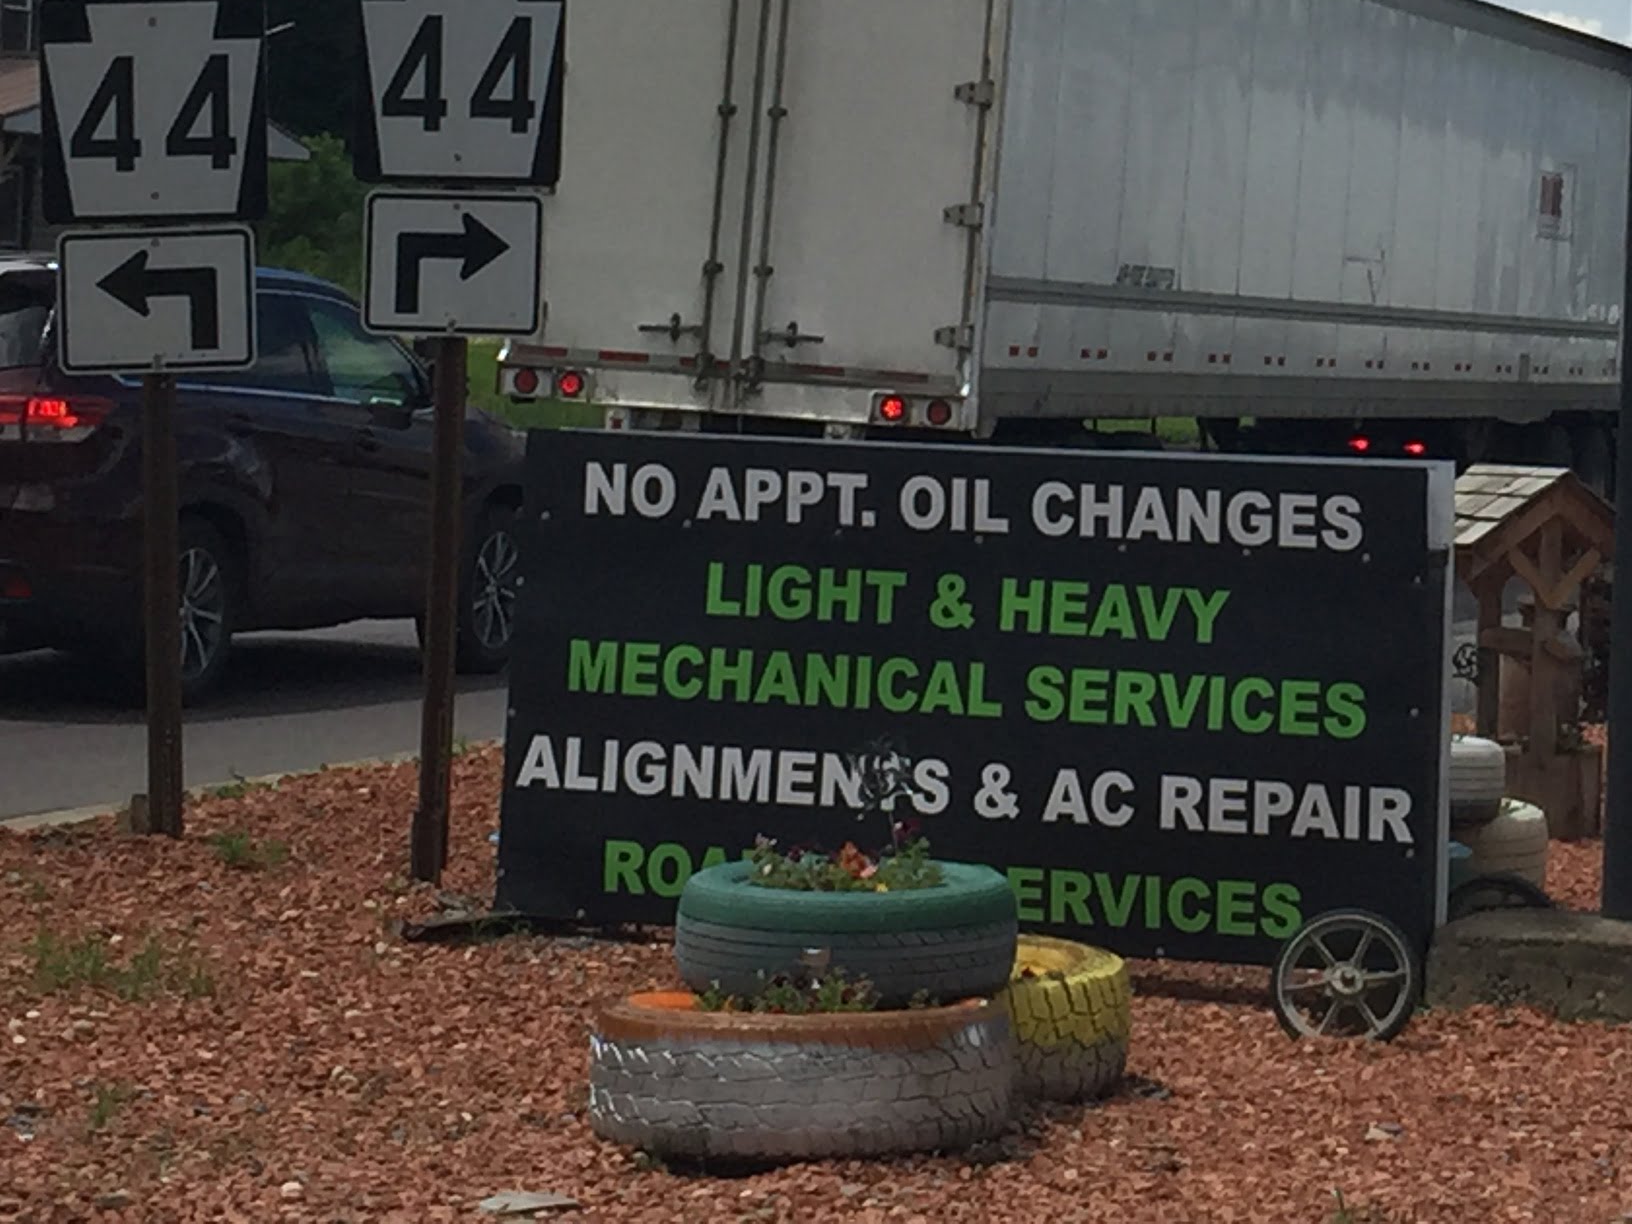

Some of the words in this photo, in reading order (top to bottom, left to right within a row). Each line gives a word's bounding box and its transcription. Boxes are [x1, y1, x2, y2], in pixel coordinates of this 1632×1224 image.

[70, 53, 237, 173] 44
[381, 14, 535, 134] 44
[584, 461, 676, 519] NO
[697, 467, 877, 528] APPT.
[900, 476, 1009, 536] OIL
[1032, 481, 1364, 551] CHANGES
[705, 561, 908, 625] LIGHT
[930, 575, 974, 630] &
[1000, 578, 1231, 644] HEAVY
[566, 639, 1001, 718] MECHANICAL
[1024, 666, 1367, 740] SERVICES
[974, 762, 1019, 819] &
[1044, 769, 1135, 827] AC
[1160, 777, 1414, 844] REPAIR
[1005, 865, 1304, 940] ERVICES
